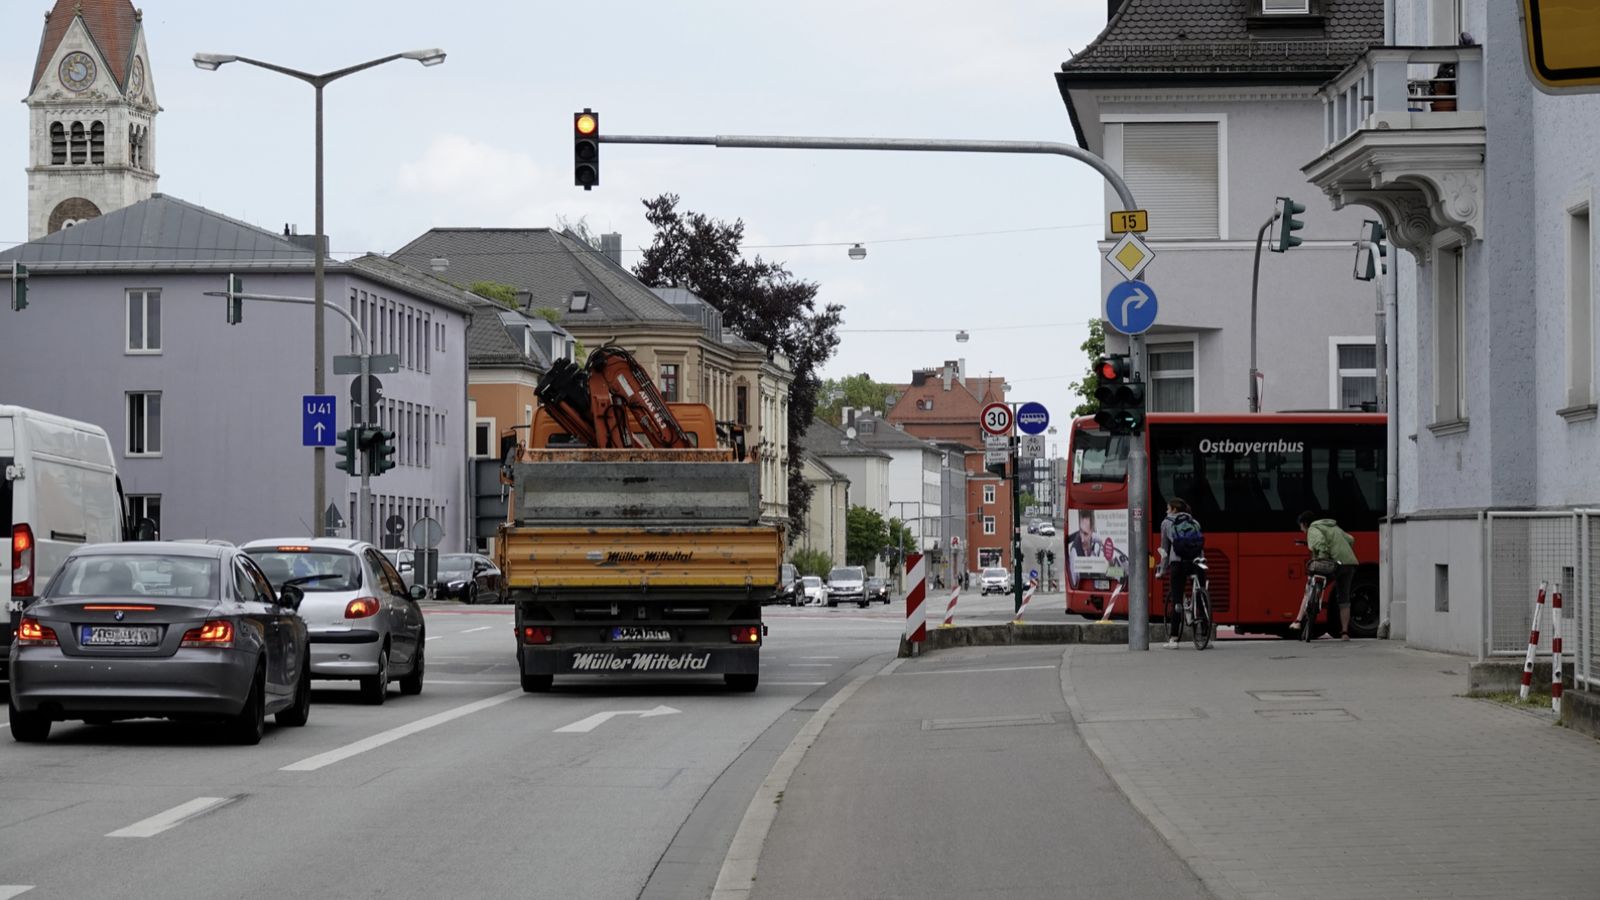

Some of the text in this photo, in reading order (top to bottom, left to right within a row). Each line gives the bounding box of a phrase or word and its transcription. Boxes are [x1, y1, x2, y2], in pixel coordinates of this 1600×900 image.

[1121, 214, 1137, 230] 15
[638, 390, 656, 412] ATLAS
[987, 411, 1006, 427] 30
[1198, 438, 1305, 456] Ostbayernbus
[606, 551, 694, 562] Müller Mitteltal
[572, 653, 711, 671] Müller Mitteltal
